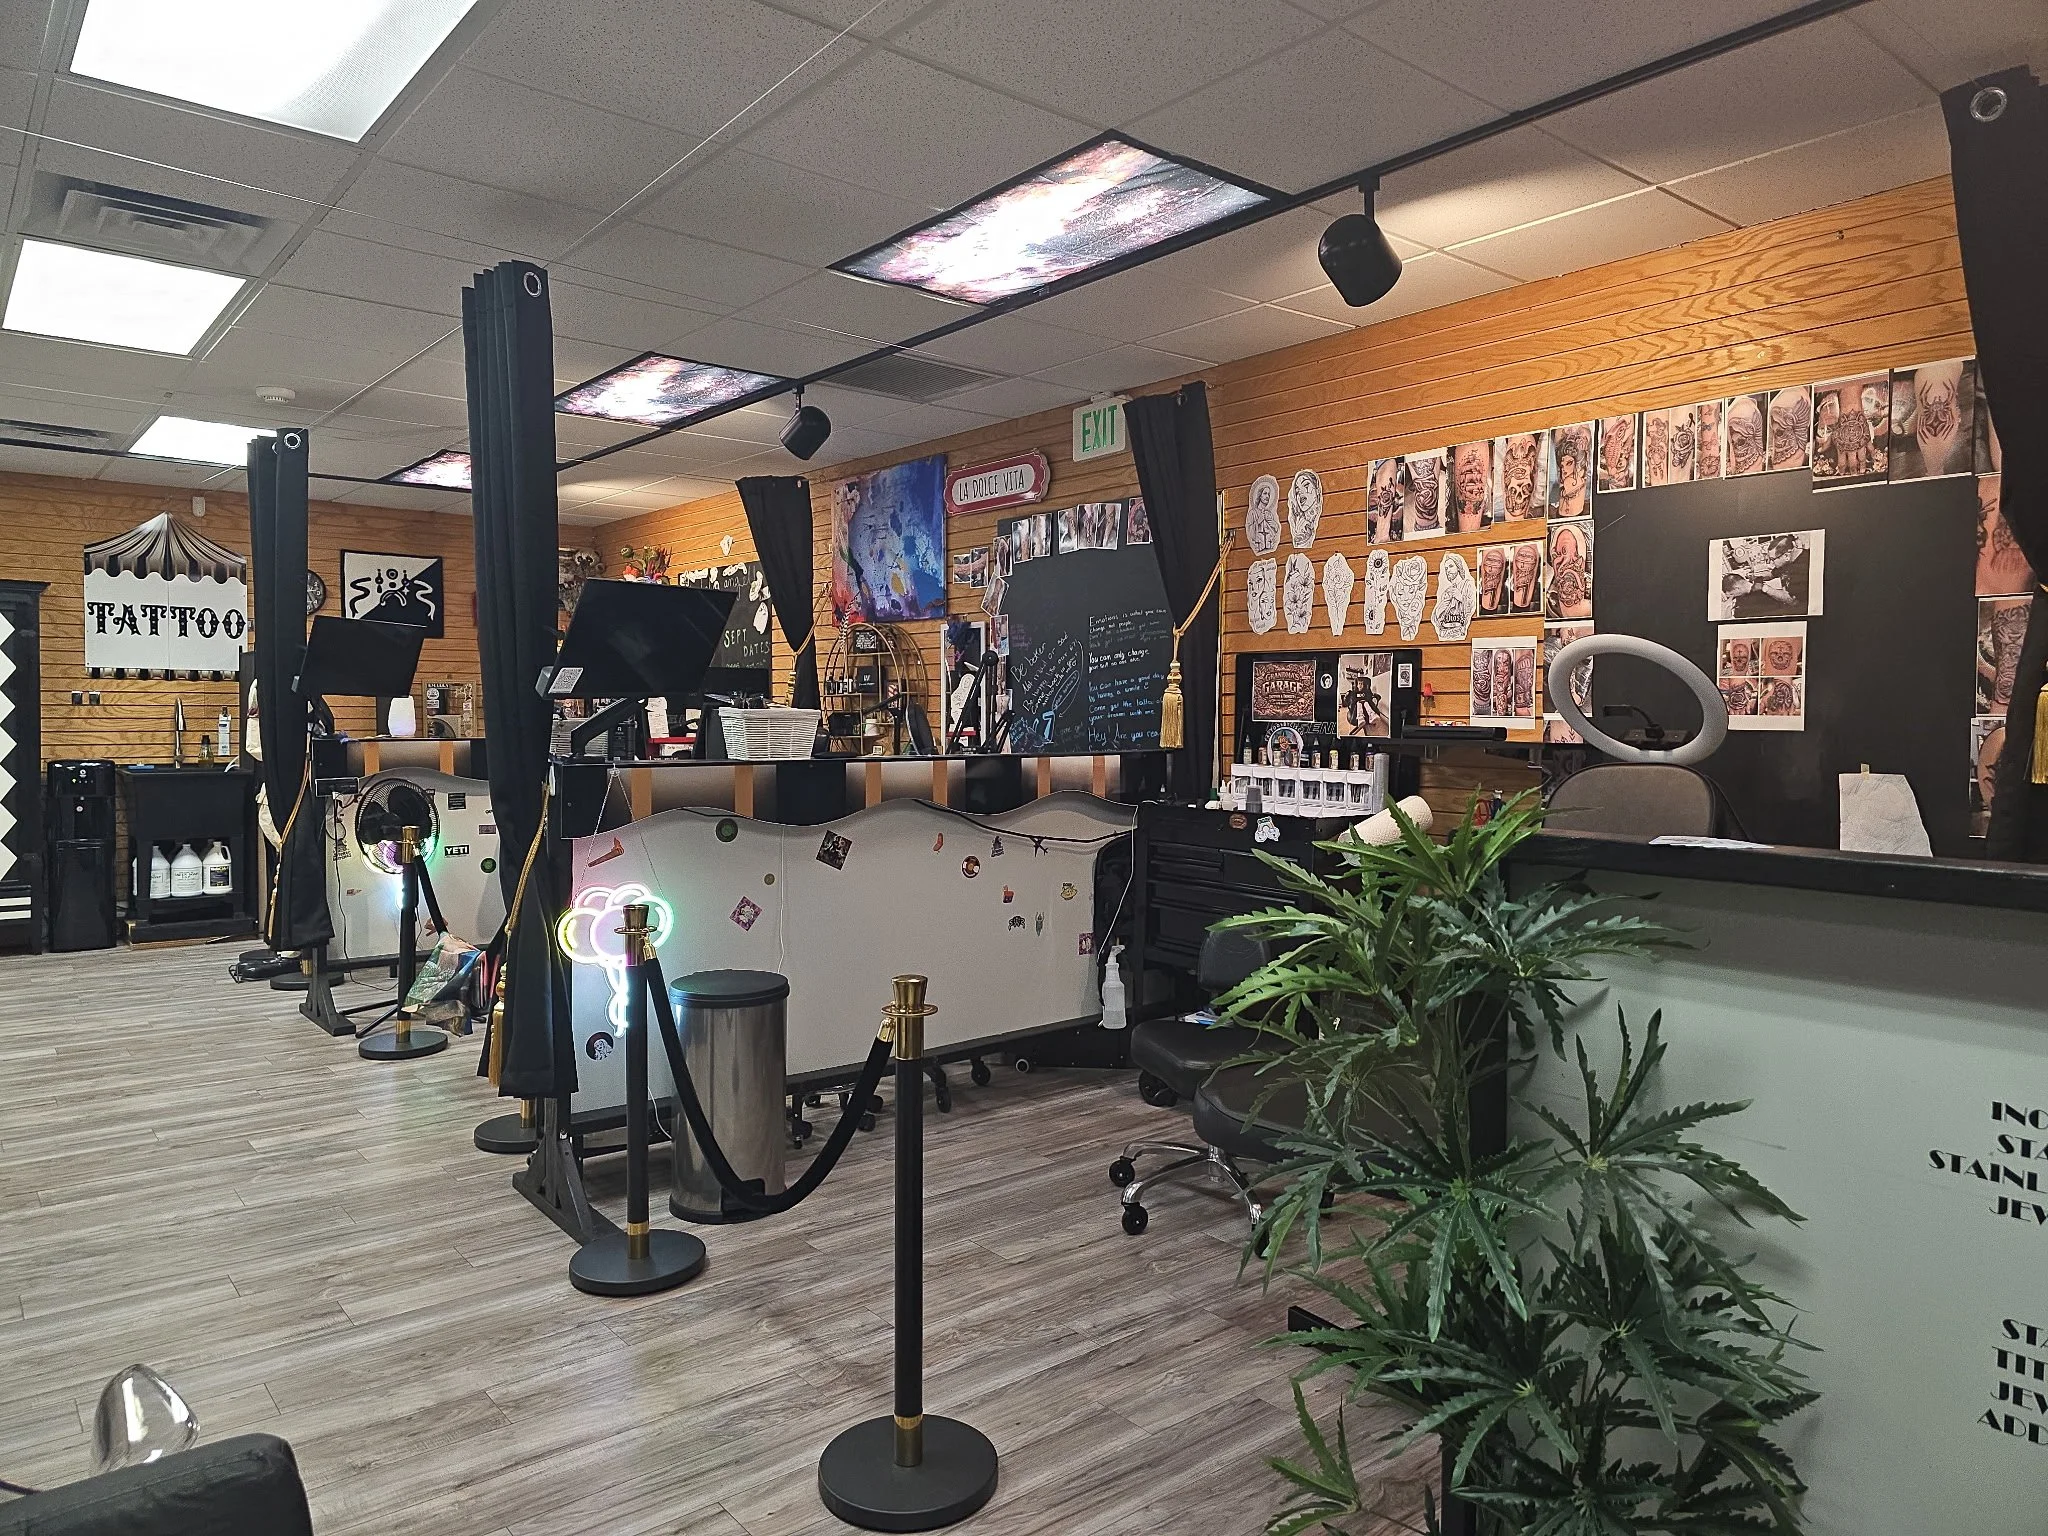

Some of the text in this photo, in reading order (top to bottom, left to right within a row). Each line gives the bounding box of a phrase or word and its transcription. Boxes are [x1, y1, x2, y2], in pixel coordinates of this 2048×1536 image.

[1082, 405, 1117, 452] EXIT
[959, 469, 1025, 501] LA DOLCE VITA
[87, 602, 246, 639] TATTOO
[724, 628, 746, 648] SEPT
[743, 641, 770, 657] DATES
[1262, 680, 1303, 693] GARAGE
[446, 846, 468, 854] YETI
[1928, 1149, 2048, 1194] STAINL
[1977, 1408, 2048, 1445] ADD
